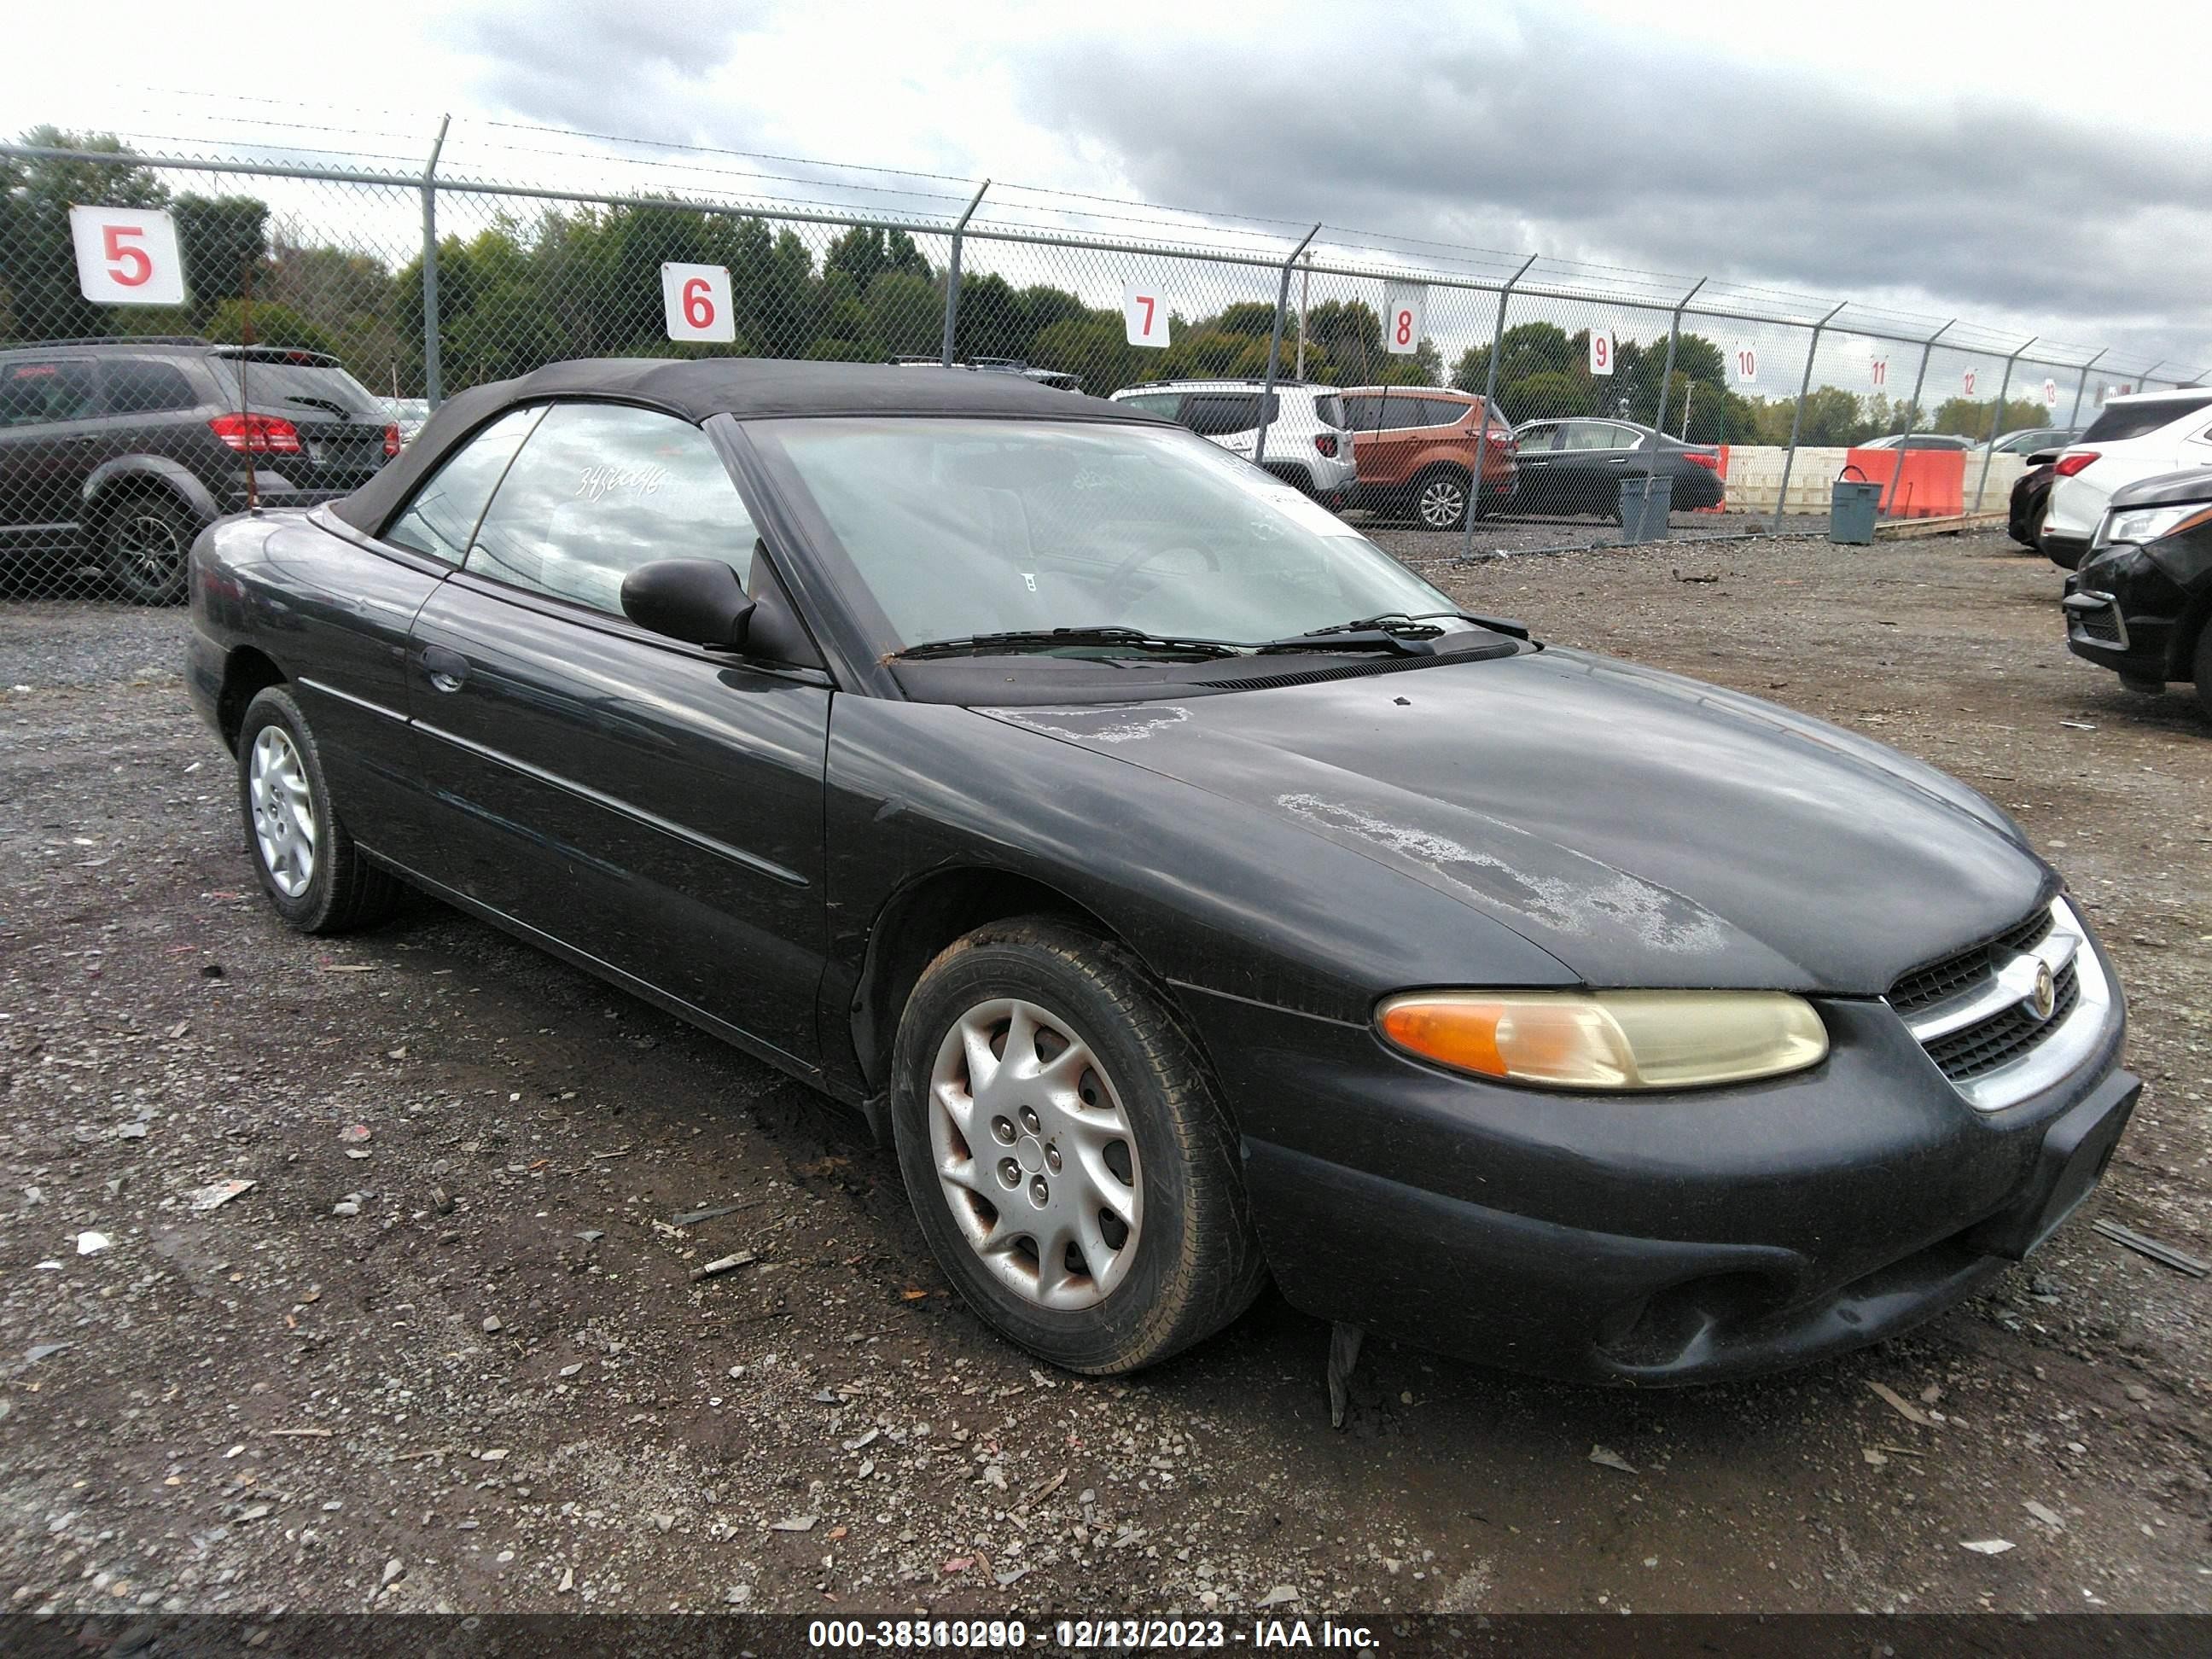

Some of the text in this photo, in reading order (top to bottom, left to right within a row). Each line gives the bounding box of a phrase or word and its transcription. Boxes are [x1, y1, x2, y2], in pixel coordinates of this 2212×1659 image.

[102, 224, 152, 287] 5
[683, 277, 715, 329] 6
[1136, 295, 1155, 335] 7
[1396, 310, 1412, 345] 8
[1596, 337, 1608, 367] 9
[1738, 351, 1755, 375] 10
[1872, 361, 1886, 385] 11
[1965, 373, 1975, 394] 12
[2046, 383, 2056, 404] 13
